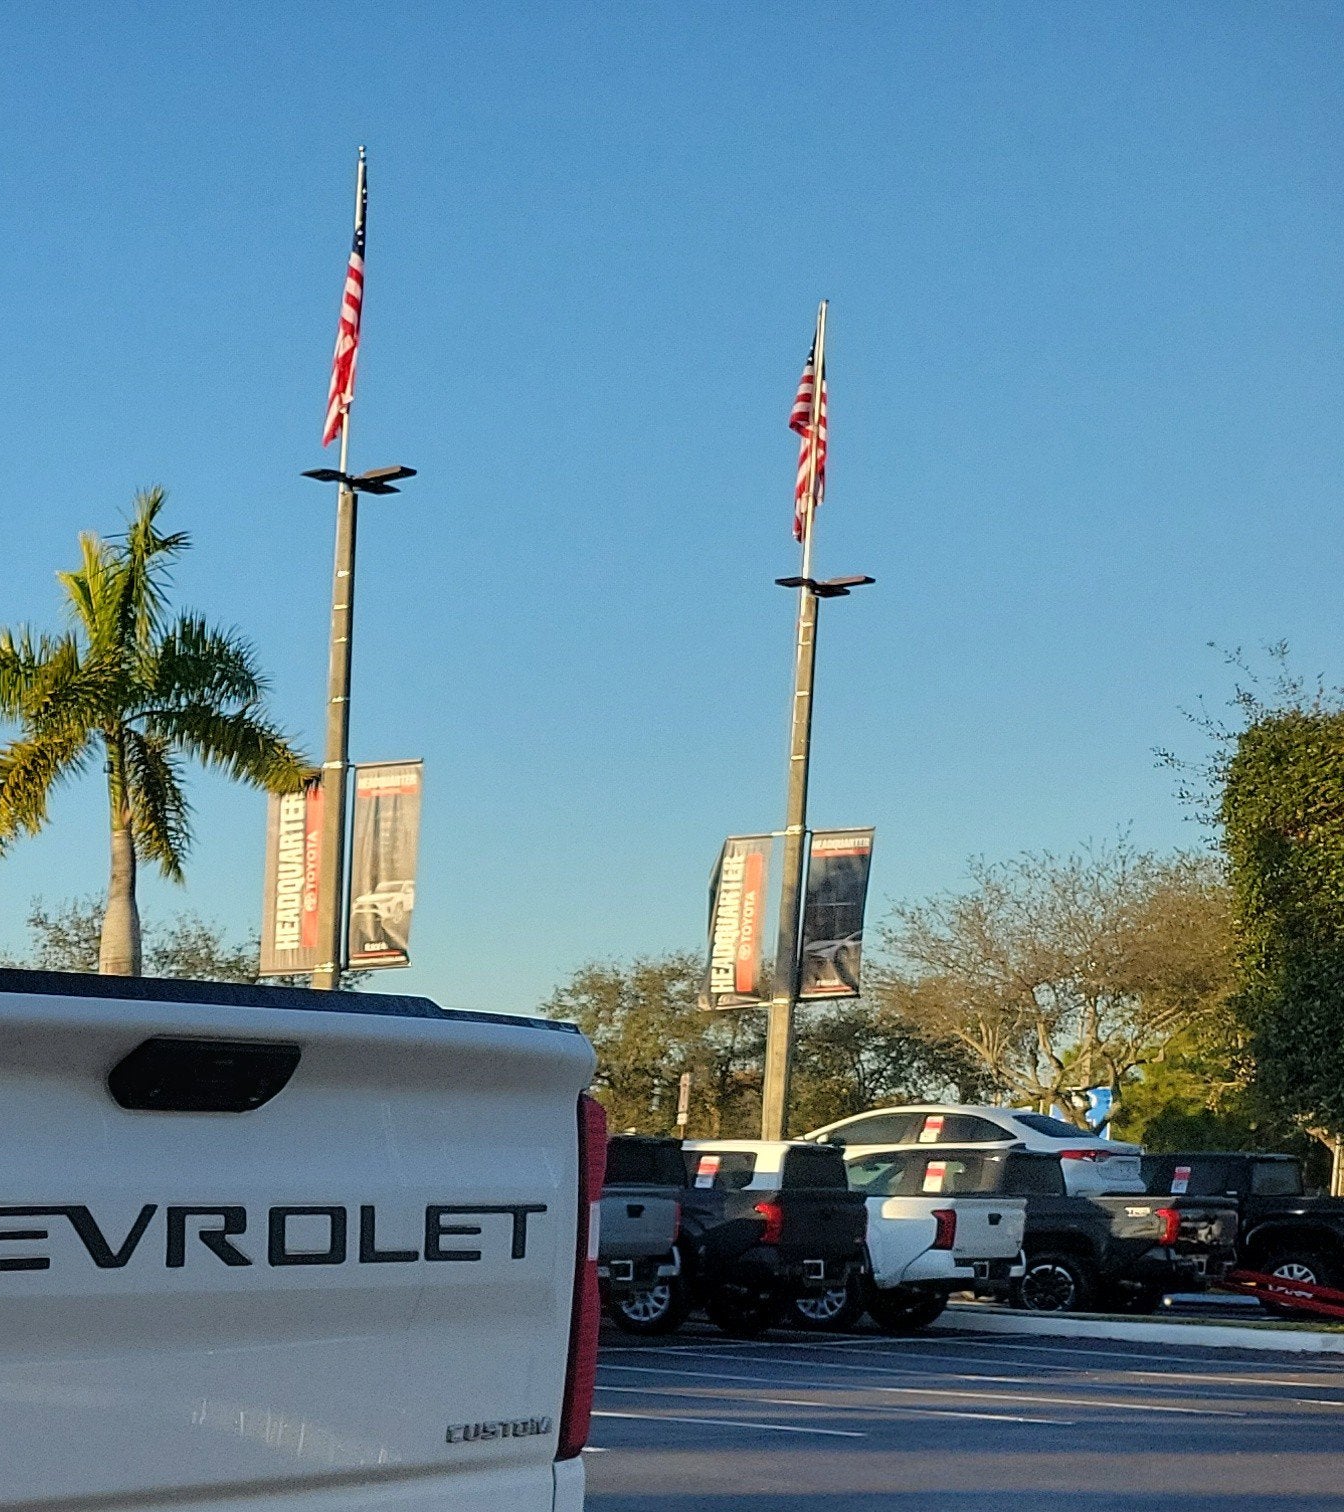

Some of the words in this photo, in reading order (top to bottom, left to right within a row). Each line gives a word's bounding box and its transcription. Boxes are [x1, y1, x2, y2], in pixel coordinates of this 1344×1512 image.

[306, 830, 319, 892] TOYOTA
[710, 850, 746, 993] HEADQUARTER
[741, 890, 756, 942] TOYOTA
[446, 1417, 552, 1443] CUSTOM
